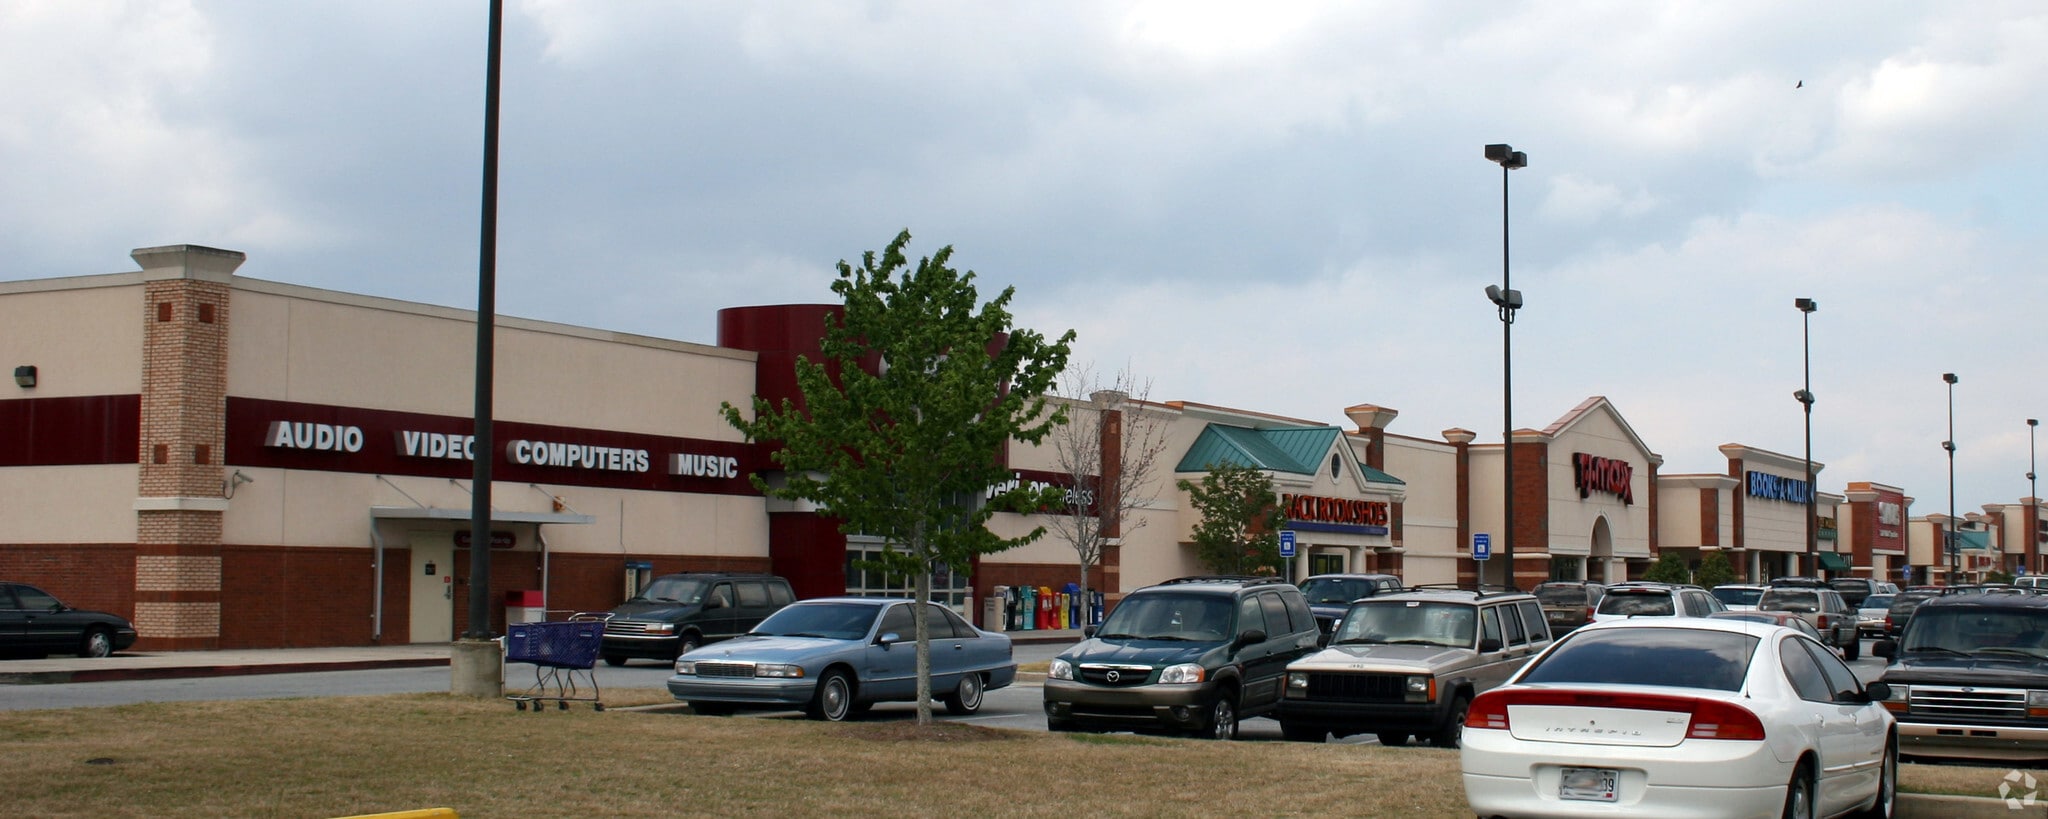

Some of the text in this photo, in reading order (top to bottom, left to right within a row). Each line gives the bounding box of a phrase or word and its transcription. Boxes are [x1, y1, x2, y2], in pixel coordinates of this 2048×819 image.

[273, 420, 739, 479] AUDIO VIDEO COMPUTERS MUSIC
[1319, 497, 1353, 524] ROOM
[1354, 499, 1389, 526] SHOES
